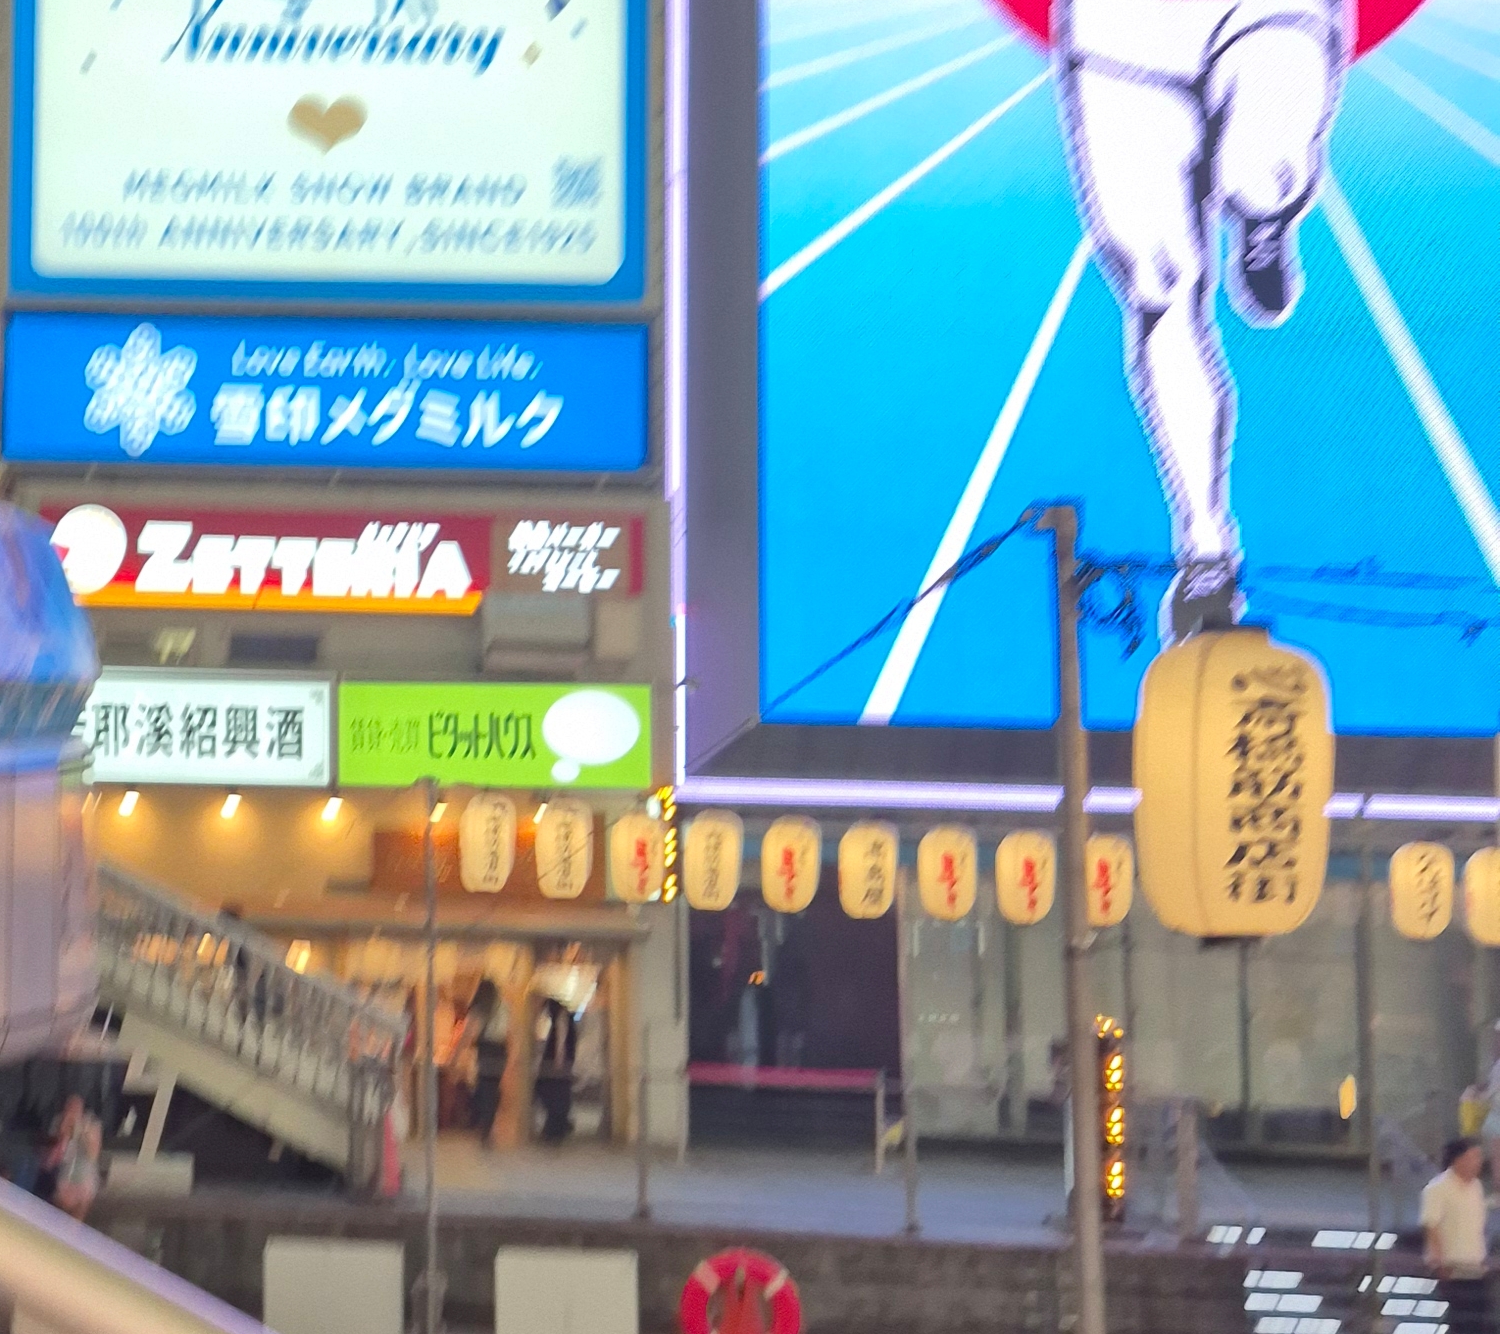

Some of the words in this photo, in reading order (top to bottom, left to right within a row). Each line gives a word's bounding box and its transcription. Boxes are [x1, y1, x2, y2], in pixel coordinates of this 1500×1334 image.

[231, 338, 301, 378] Love
[403, 342, 474, 381] Love
[210, 378, 565, 449] 雪印メグミルク
[72, 702, 305, 761] 耶溪紹興酒
